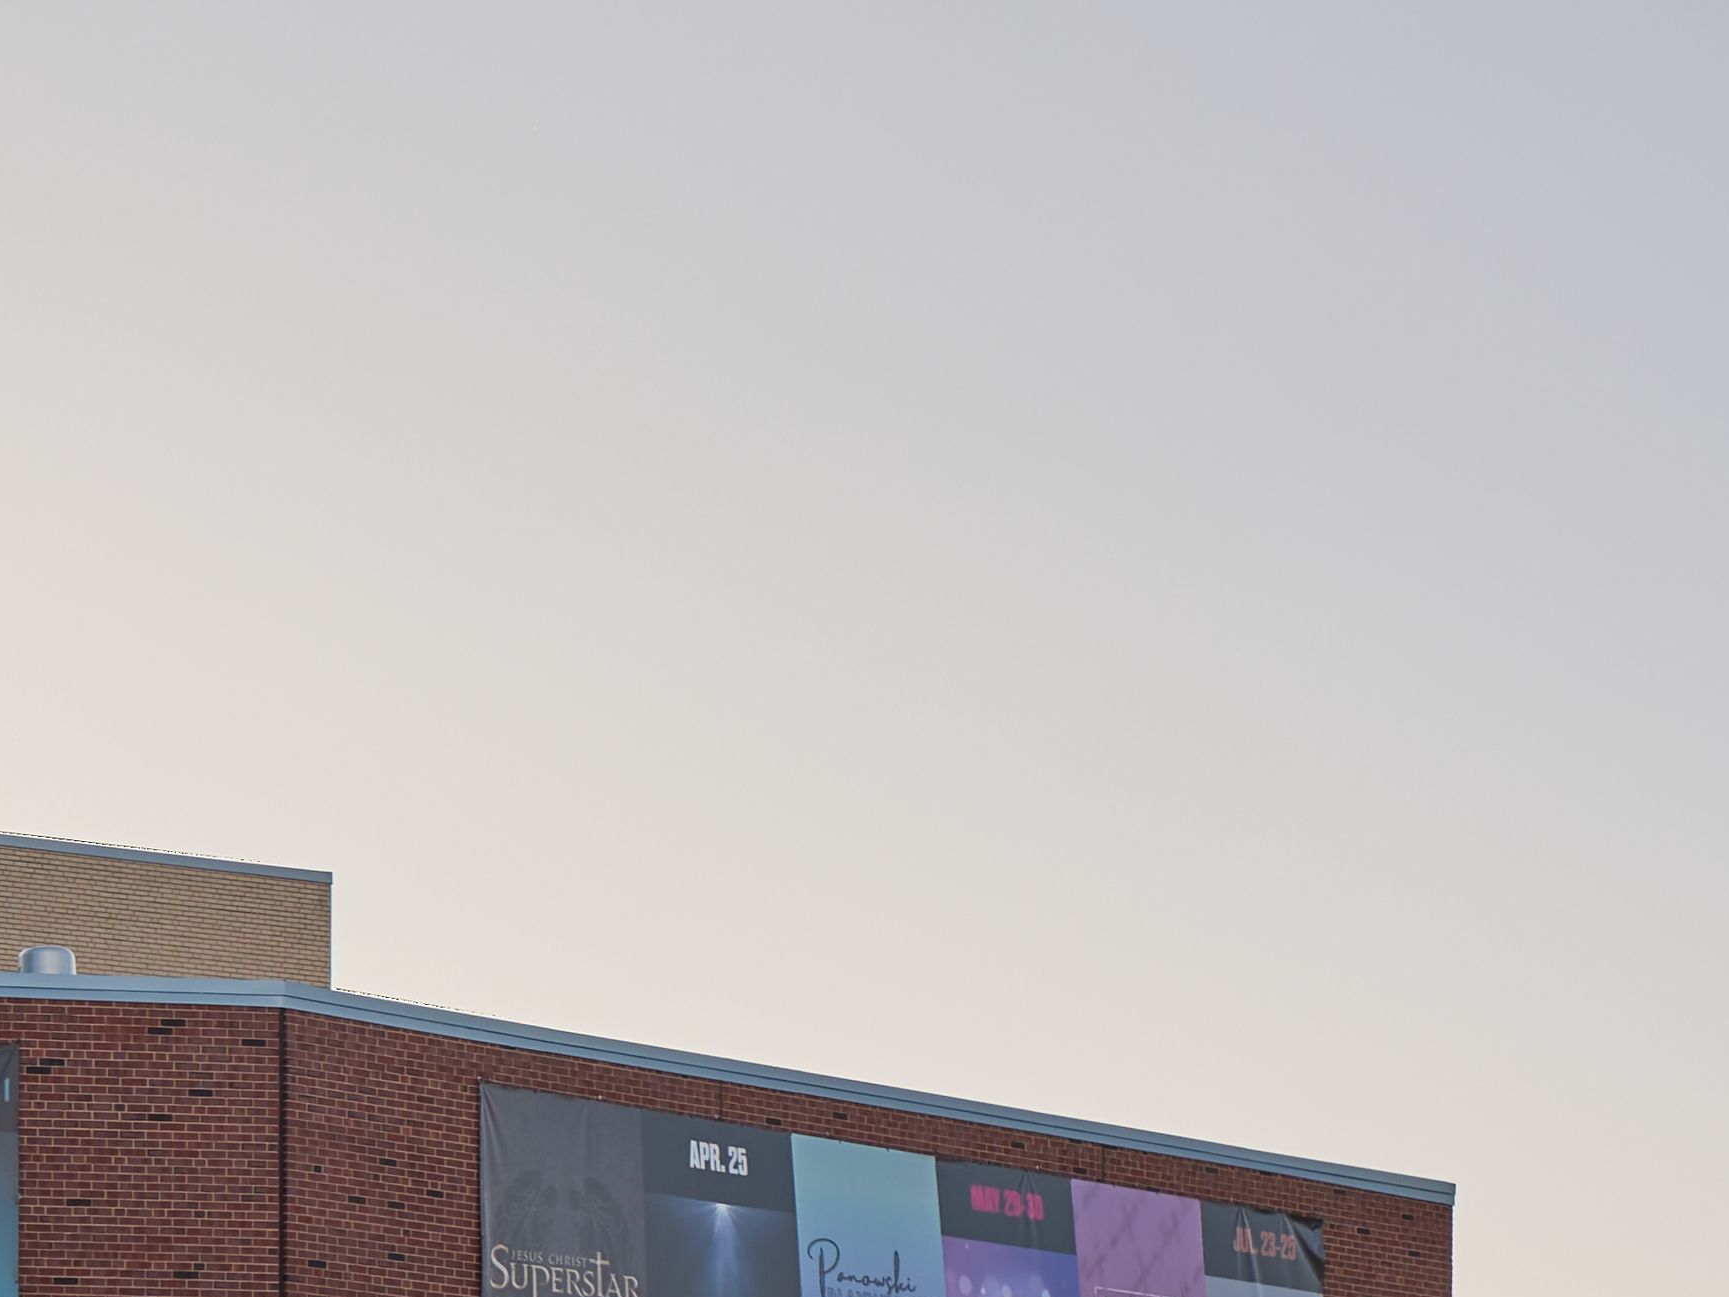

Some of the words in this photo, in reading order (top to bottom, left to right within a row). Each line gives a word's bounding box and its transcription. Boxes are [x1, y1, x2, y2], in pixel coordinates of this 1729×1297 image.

[690, 1139, 726, 1173] APR.
[728, 1146, 748, 1176] 25
[971, 1184, 1000, 1214] MAY
[511, 1249, 543, 1263] JESUS
[548, 1253, 588, 1268] CHRIST
